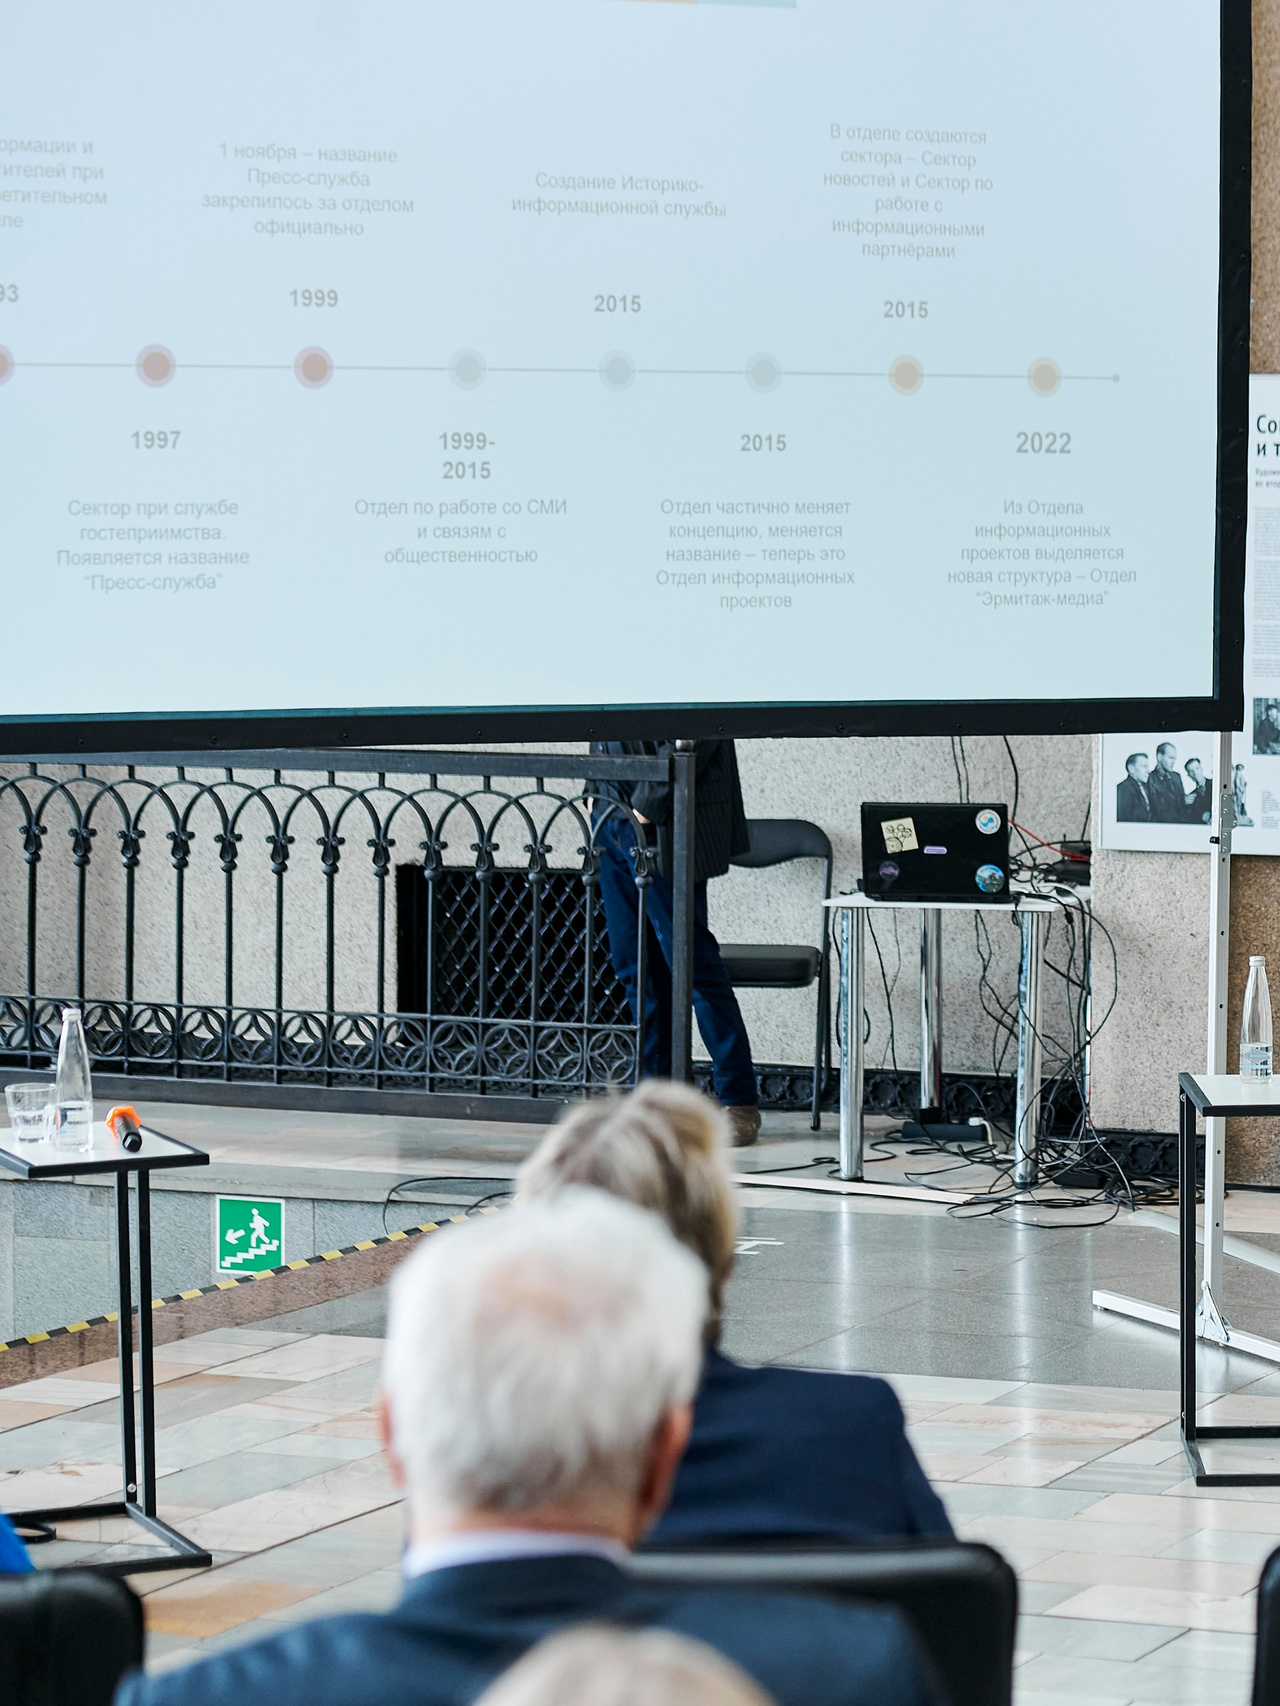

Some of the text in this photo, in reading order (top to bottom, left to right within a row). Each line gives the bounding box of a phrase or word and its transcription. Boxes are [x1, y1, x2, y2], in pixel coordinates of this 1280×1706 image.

[829, 122, 987, 146] В отделе создаются
[82, 141, 94, 155] и
[219, 142, 227, 158] 1
[233, 142, 298, 164] ноября
[317, 148, 399, 164] название
[840, 150, 903, 168] сектора
[920, 149, 977, 171] Сектор
[71, 165, 105, 184] при
[247, 167, 371, 191] Пресс-служба
[534, 171, 704, 195] Создание Историко-
[823, 172, 994, 192] новостей и Сектор по
[0, 189, 108, 205] етительном
[201, 194, 415, 215] закрепилось за отделом
[874, 195, 943, 215] работе с
[511, 196, 727, 219] информационной службы
[0, 214, 25, 229] ле
[253, 218, 365, 238] официально
[831, 218, 985, 238] информационными
[861, 243, 956, 262] партнёрами
[289, 288, 339, 308] 1999
[593, 293, 642, 314] 2015
[883, 300, 929, 319] 2015
[131, 430, 182, 450] 1997
[439, 431, 496, 451] 1999-
[740, 433, 787, 453] 2015
[1015, 431, 1072, 455] 2022
[1256, 443, 1267, 457] и
[442, 460, 492, 480] 2015
[66, 498, 239, 520] Сектор при службе
[354, 498, 568, 519] Отдел по работе со СМИ
[660, 498, 851, 518] Отдел частично меняет
[1003, 499, 1084, 518] Из Отдела
[79, 526, 226, 544] гостеприимства.
[417, 525, 507, 540] и связям с
[668, 525, 843, 541] концепцию, меняется
[974, 522, 1111, 542] информационных
[56, 549, 251, 566] Появляется название
[384, 546, 539, 567] общественностью
[665, 548, 742, 562] название
[760, 548, 816, 566] теперь
[819, 548, 846, 561] это
[960, 547, 1125, 565] проектов выделяется
[83, 572, 223, 595] “Пресс-служба”
[655, 569, 855, 589] Отдел информационных
[947, 570, 994, 584] новая
[997, 570, 1072, 587] структура
[1089, 567, 1137, 586] Отдел
[719, 595, 793, 613] проектов
[975, 590, 1110, 611] “Эрмитаж-медиа”
